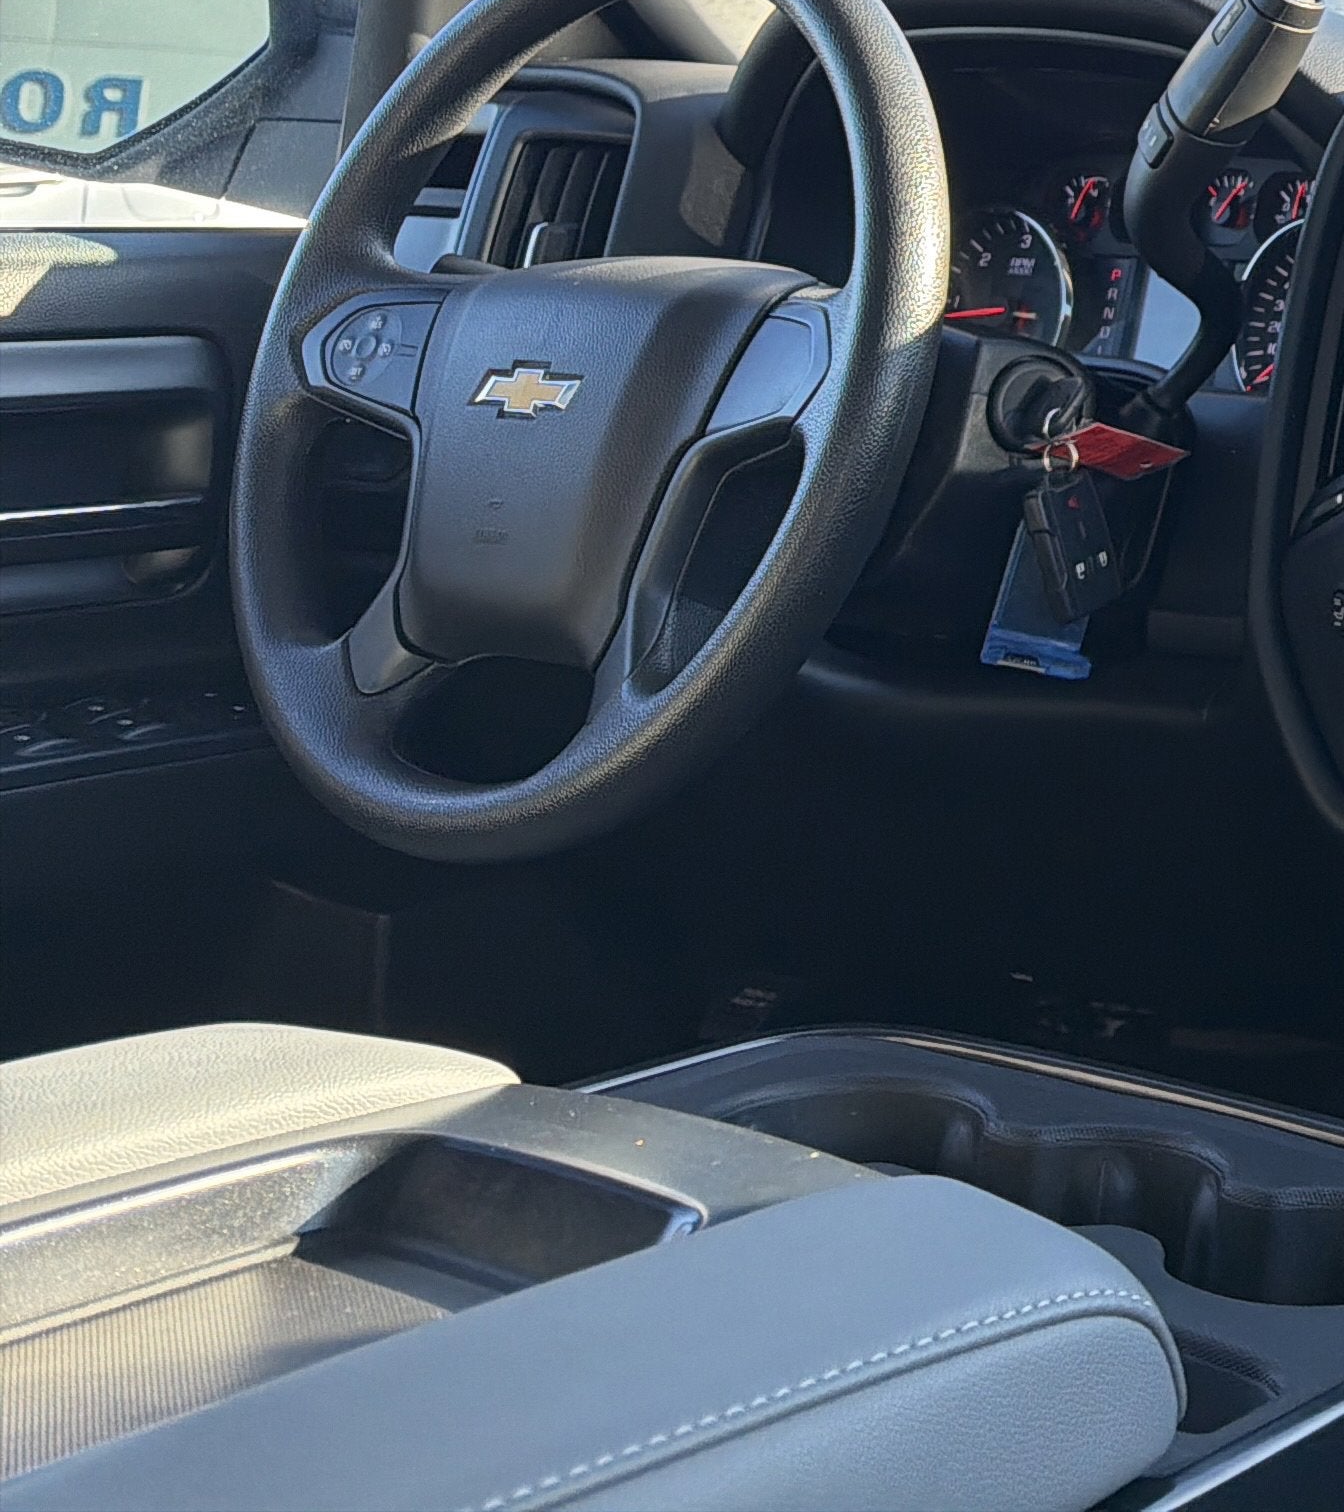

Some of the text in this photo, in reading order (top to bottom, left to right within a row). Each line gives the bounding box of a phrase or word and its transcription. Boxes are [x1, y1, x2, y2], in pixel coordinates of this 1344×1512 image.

[1020, 234, 1032, 249] 3
[979, 252, 992, 267] 2
[1111, 269, 1122, 281] P
[1108, 287, 1118, 300] R
[1104, 307, 1115, 320] N
